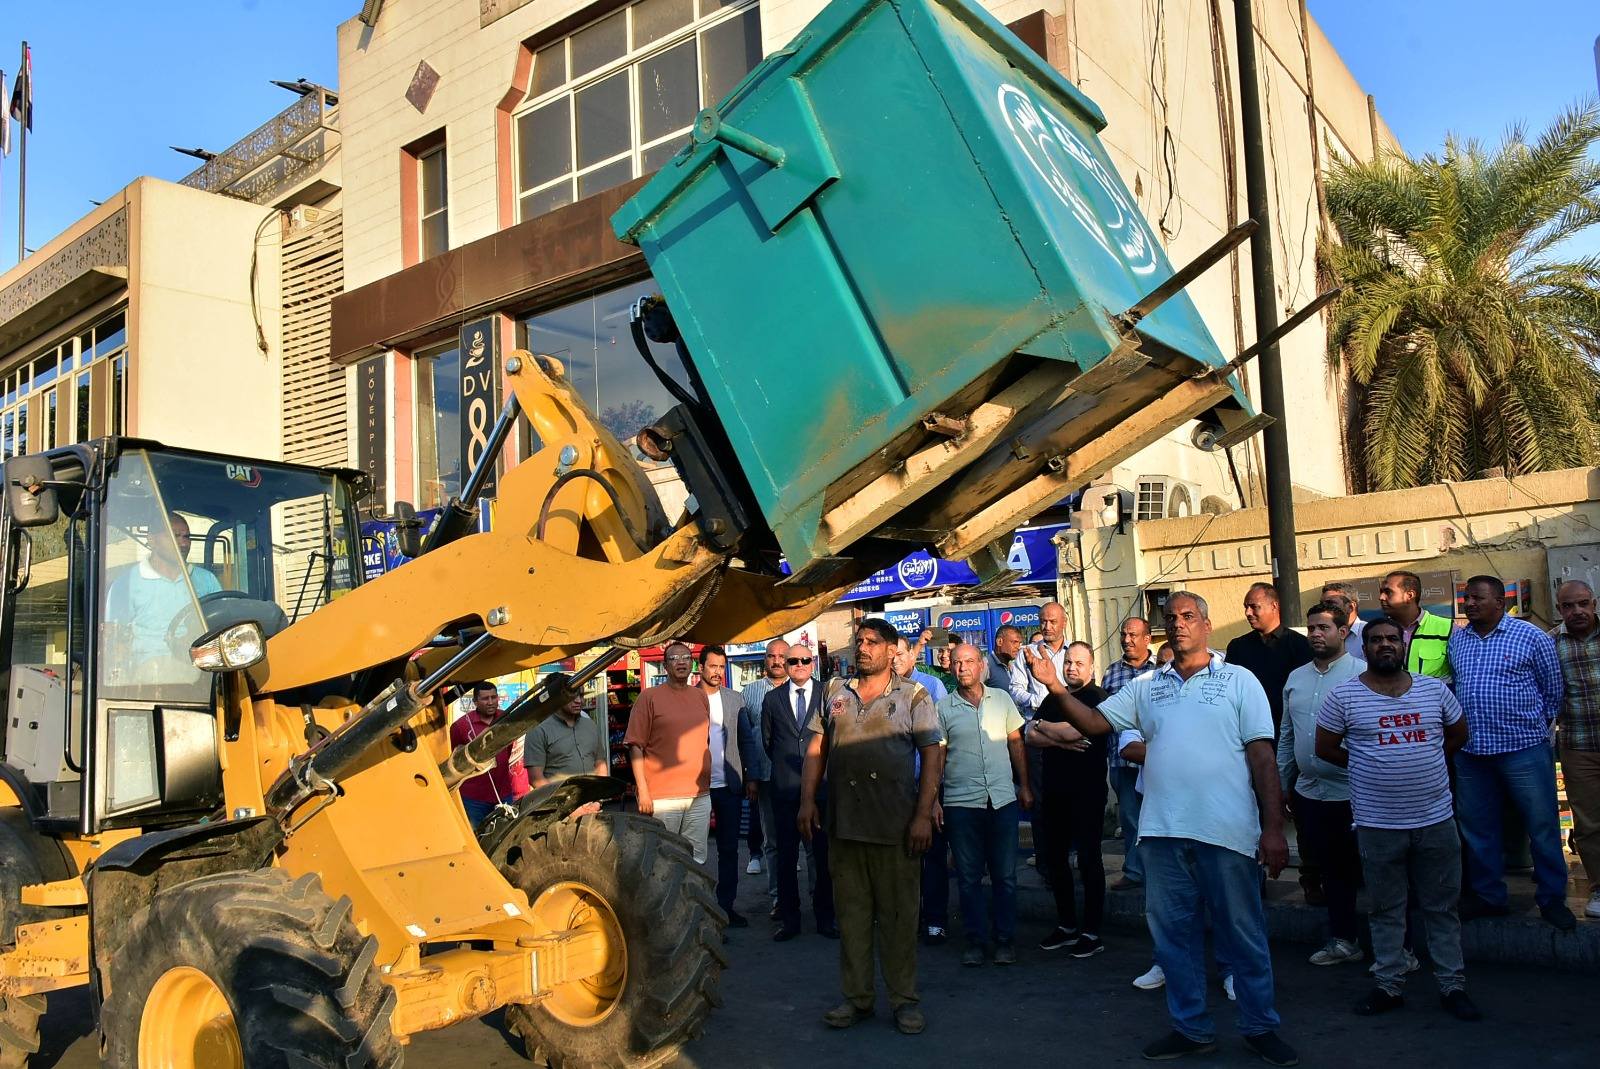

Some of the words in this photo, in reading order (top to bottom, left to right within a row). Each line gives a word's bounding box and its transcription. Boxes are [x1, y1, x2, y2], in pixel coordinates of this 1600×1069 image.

[367, 365, 376, 477] MÖVENPIC
[226, 463, 252, 482] CAT
[955, 617, 981, 629] pepsi
[1014, 612, 1040, 625] peps
[1378, 712, 1422, 729] C'EST
[1378, 732, 1400, 746] LA
[1402, 730, 1427, 743] VIE
